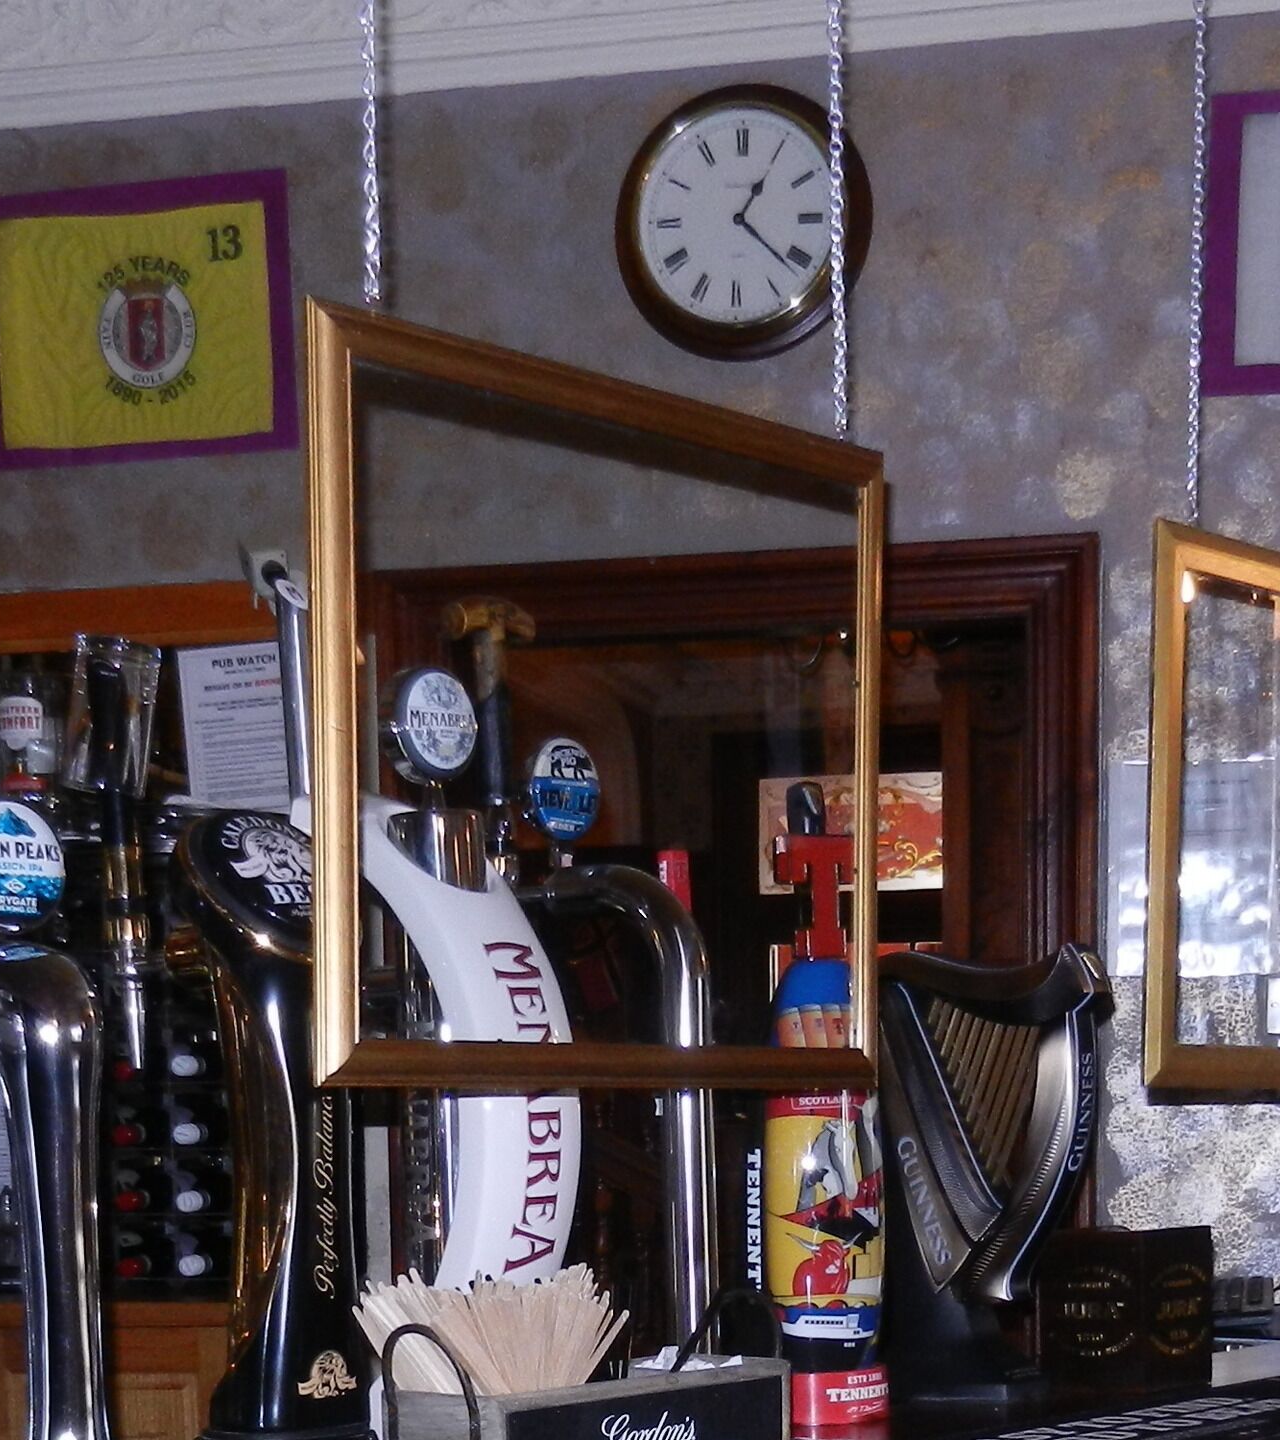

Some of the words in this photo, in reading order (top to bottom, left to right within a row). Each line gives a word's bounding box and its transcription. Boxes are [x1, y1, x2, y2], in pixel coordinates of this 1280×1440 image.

[206, 225, 243, 262] 13
[128, 255, 191, 286] YEARS
[211, 658, 234, 669] PUB
[236, 654, 276, 667] WATCH
[15, 841, 61, 862] PEAKS
[29, 863, 43, 872] IPA
[1068, 1052, 1094, 1172] GUINNESS
[897, 1136, 952, 1266] GUINNESS
[312, 1196, 340, 1300] Perfectly
